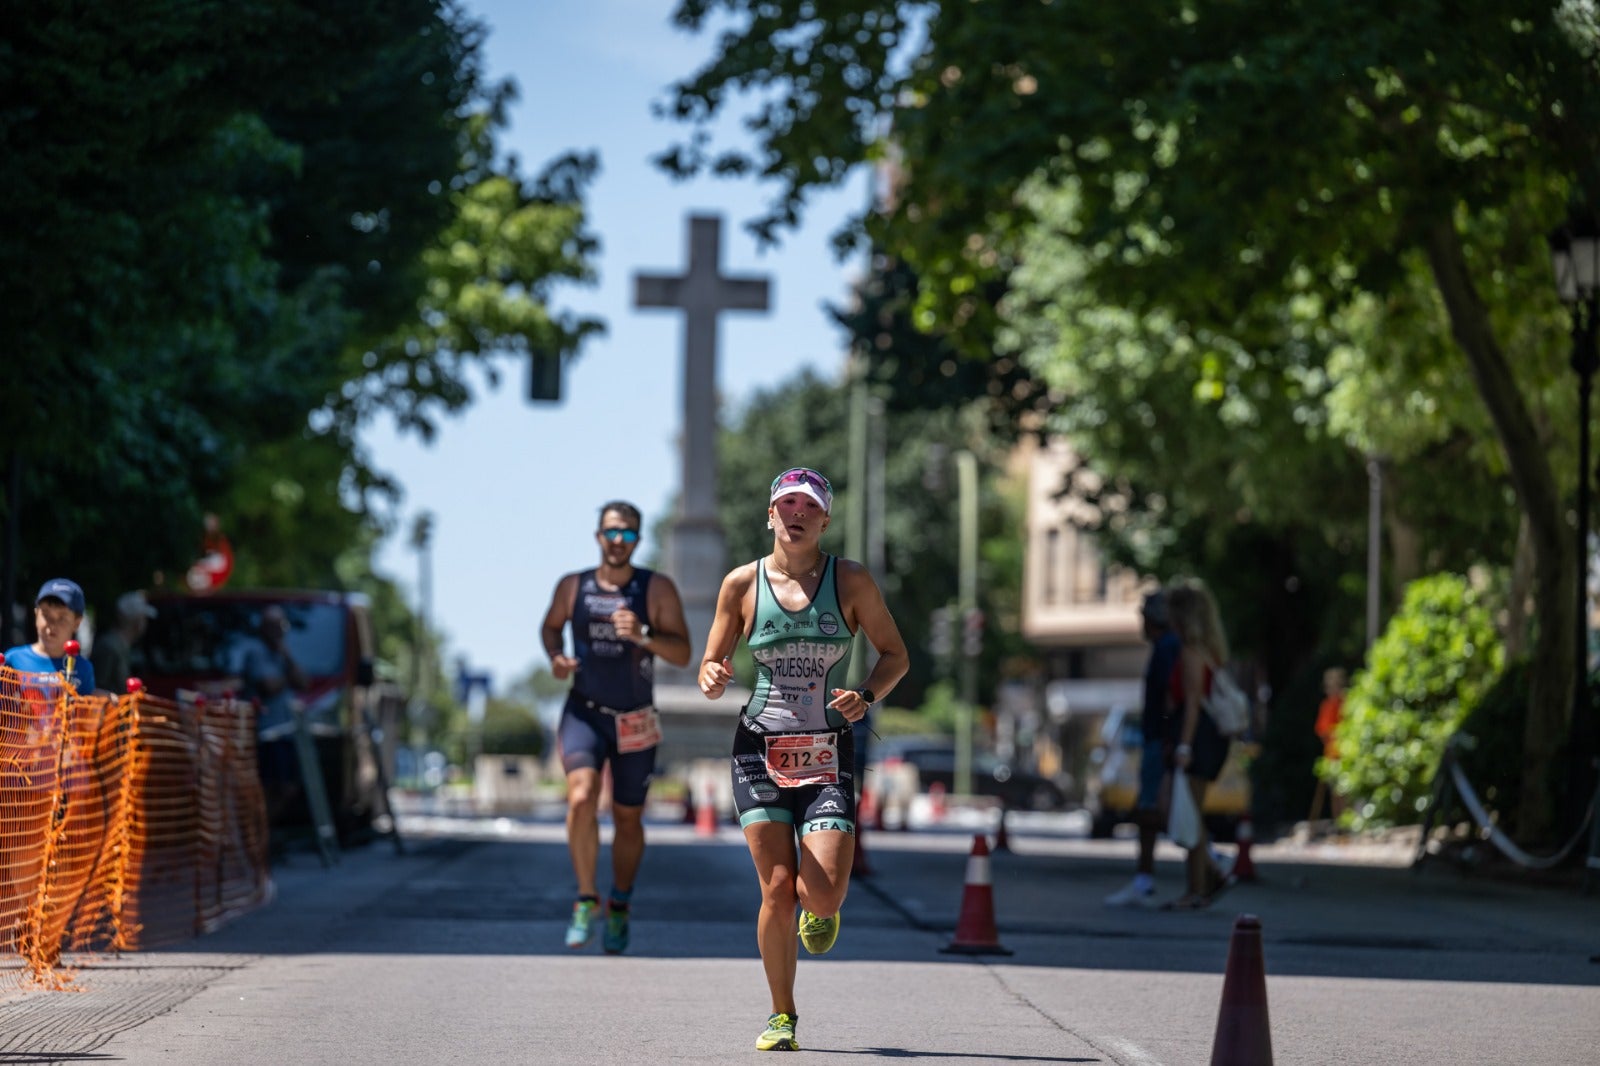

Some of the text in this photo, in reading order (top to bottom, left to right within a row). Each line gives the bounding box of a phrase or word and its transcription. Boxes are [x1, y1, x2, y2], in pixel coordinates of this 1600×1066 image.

[774, 657, 825, 678] RUESGAS
[781, 693, 799, 701] ITV
[780, 751, 812, 768] 212
[809, 821, 841, 832] CEA
